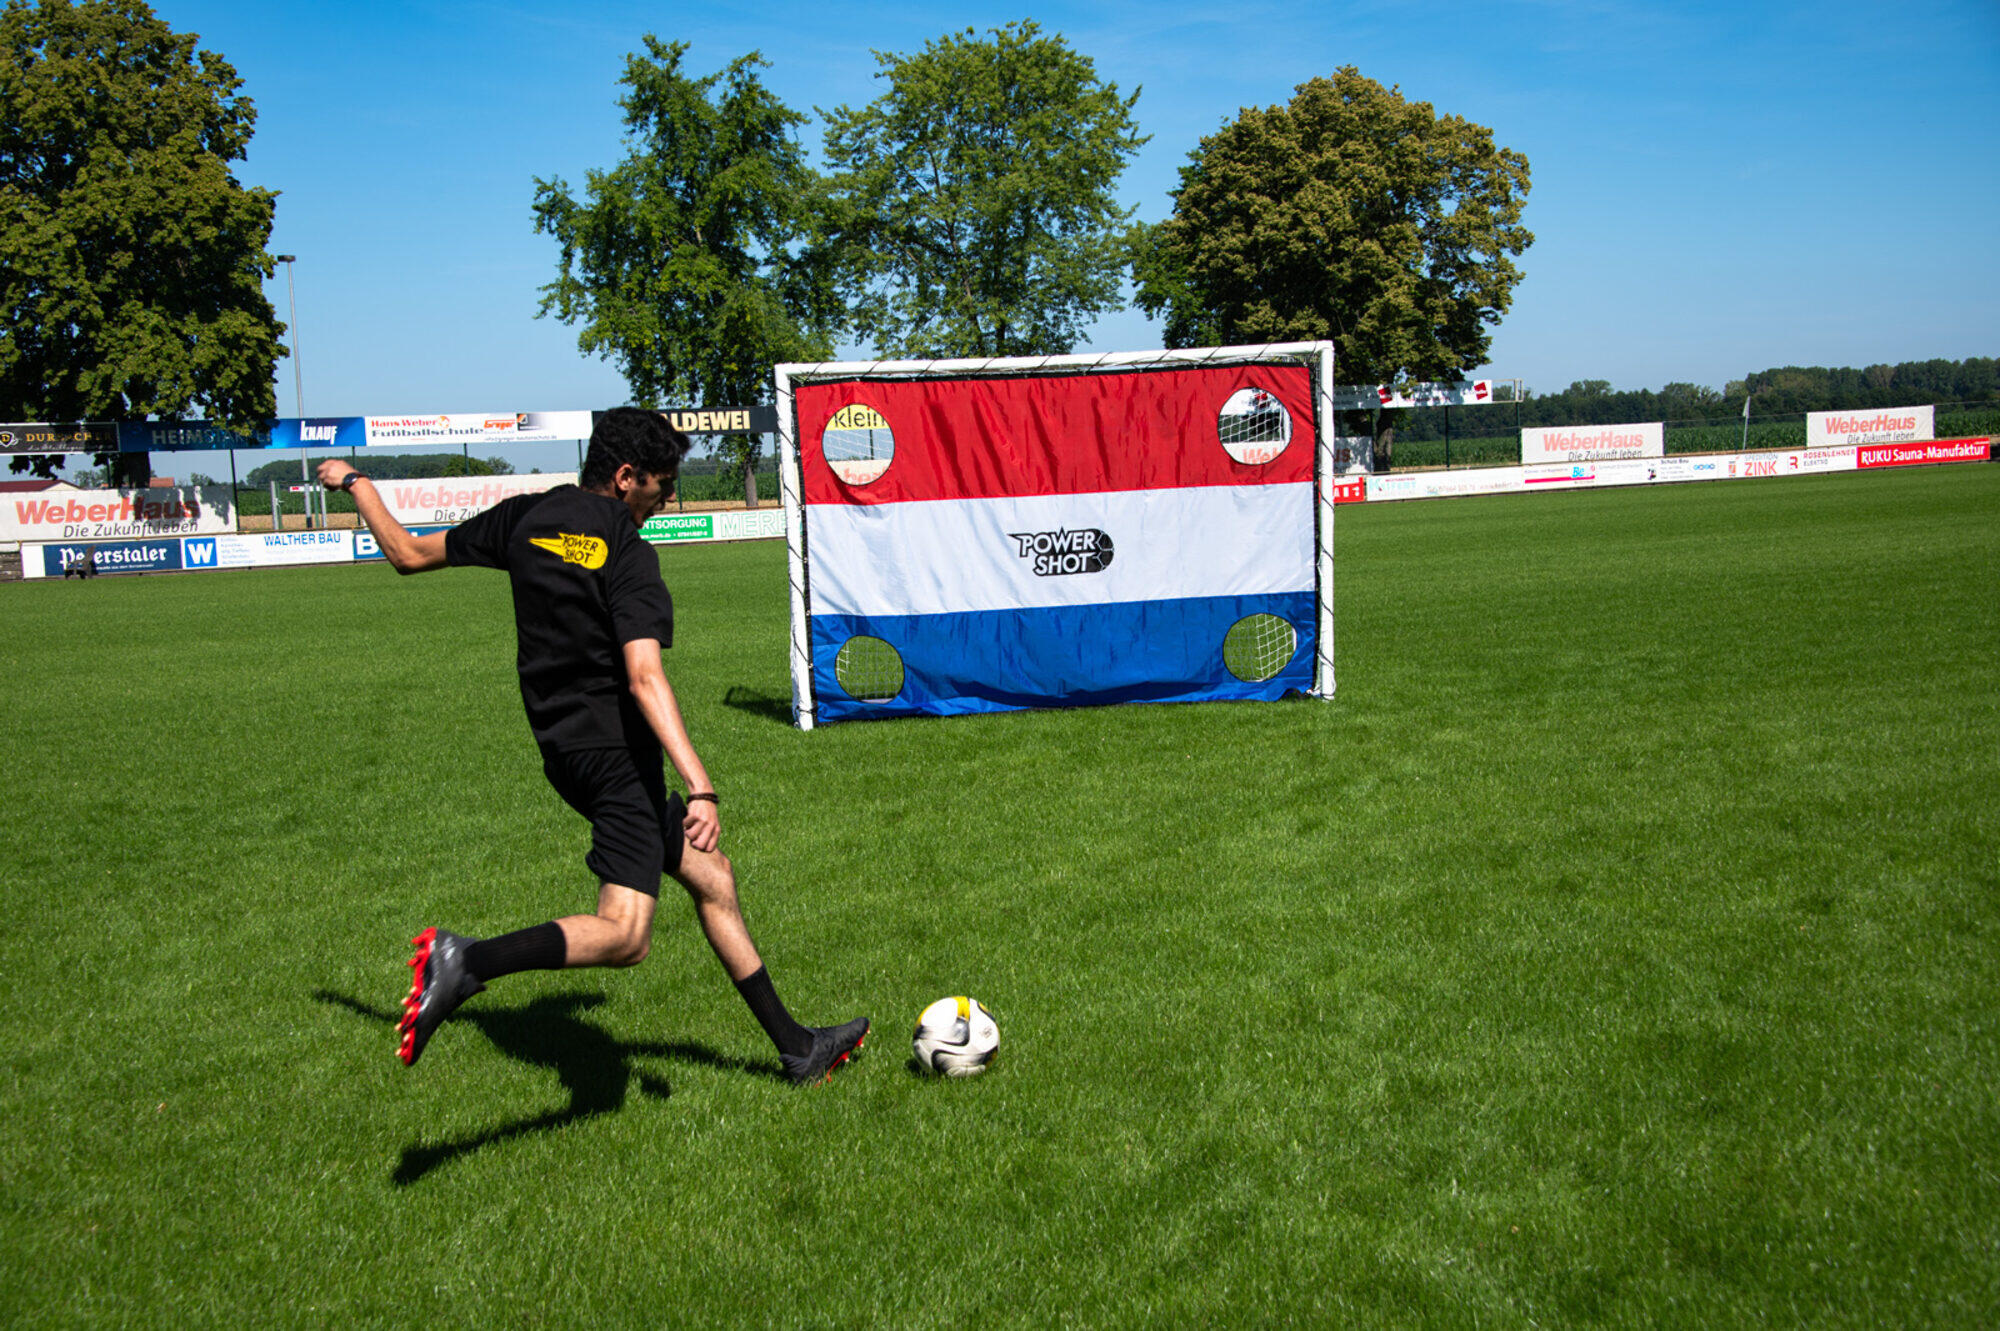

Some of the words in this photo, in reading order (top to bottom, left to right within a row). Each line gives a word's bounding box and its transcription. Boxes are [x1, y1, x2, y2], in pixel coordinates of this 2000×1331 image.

[660, 411, 751, 432] LDEWEI
[1825, 415, 1916, 435] WeberHaus
[1543, 431, 1644, 452] WeberHaus
[1847, 433, 1861, 444] Die
[1863, 433, 1892, 444] Zukunft
[1893, 431, 1915, 441] leben
[1568, 451, 1583, 461] Die
[1585, 449, 1618, 461] Zukunft
[1619, 448, 1643, 459] leben
[1861, 450, 1892, 466] RUKU
[1893, 443, 1986, 461] Sauna-Manufaktur
[1744, 460, 1778, 476] ZINK
[16, 497, 199, 525] WeberHaus
[434, 509, 456, 522] Die
[64, 524, 89, 538] Die
[93, 520, 152, 538] Zukunft
[153, 519, 199, 534] leben
[643, 517, 708, 530] NTSORGUNG
[264, 534, 316, 547] WALTHER
[319, 532, 342, 544] BAU
[562, 535, 599, 553] POWER
[1014, 530, 1097, 556] POWER
[59, 546, 167, 566] Peerstaler
[187, 542, 214, 565] W
[565, 549, 594, 564] SHOT
[1034, 552, 1096, 575] SHOT
